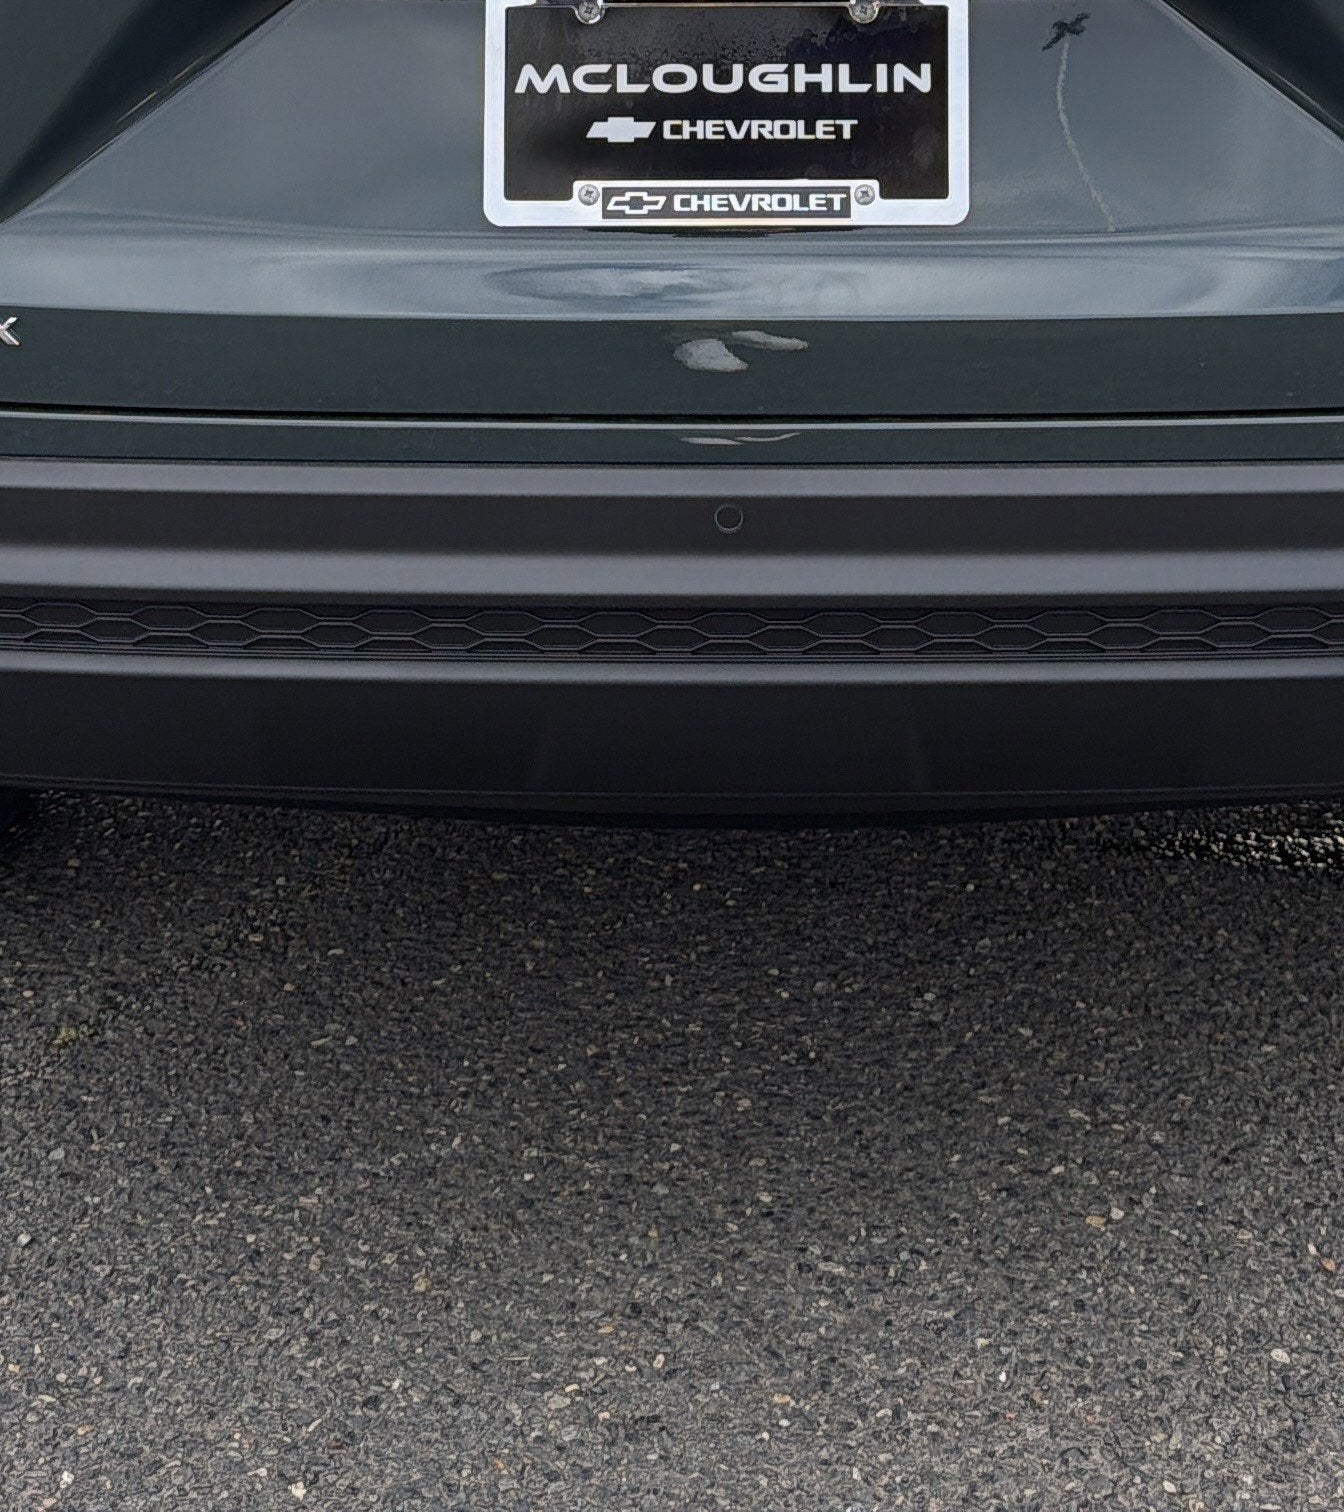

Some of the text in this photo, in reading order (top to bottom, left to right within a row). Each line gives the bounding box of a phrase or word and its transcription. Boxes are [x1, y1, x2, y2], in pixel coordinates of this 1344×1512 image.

[514, 63, 932, 94] MCLOUGHLIN
[662, 119, 858, 140] CHEVROLET
[673, 193, 846, 212] CHEVROLET
